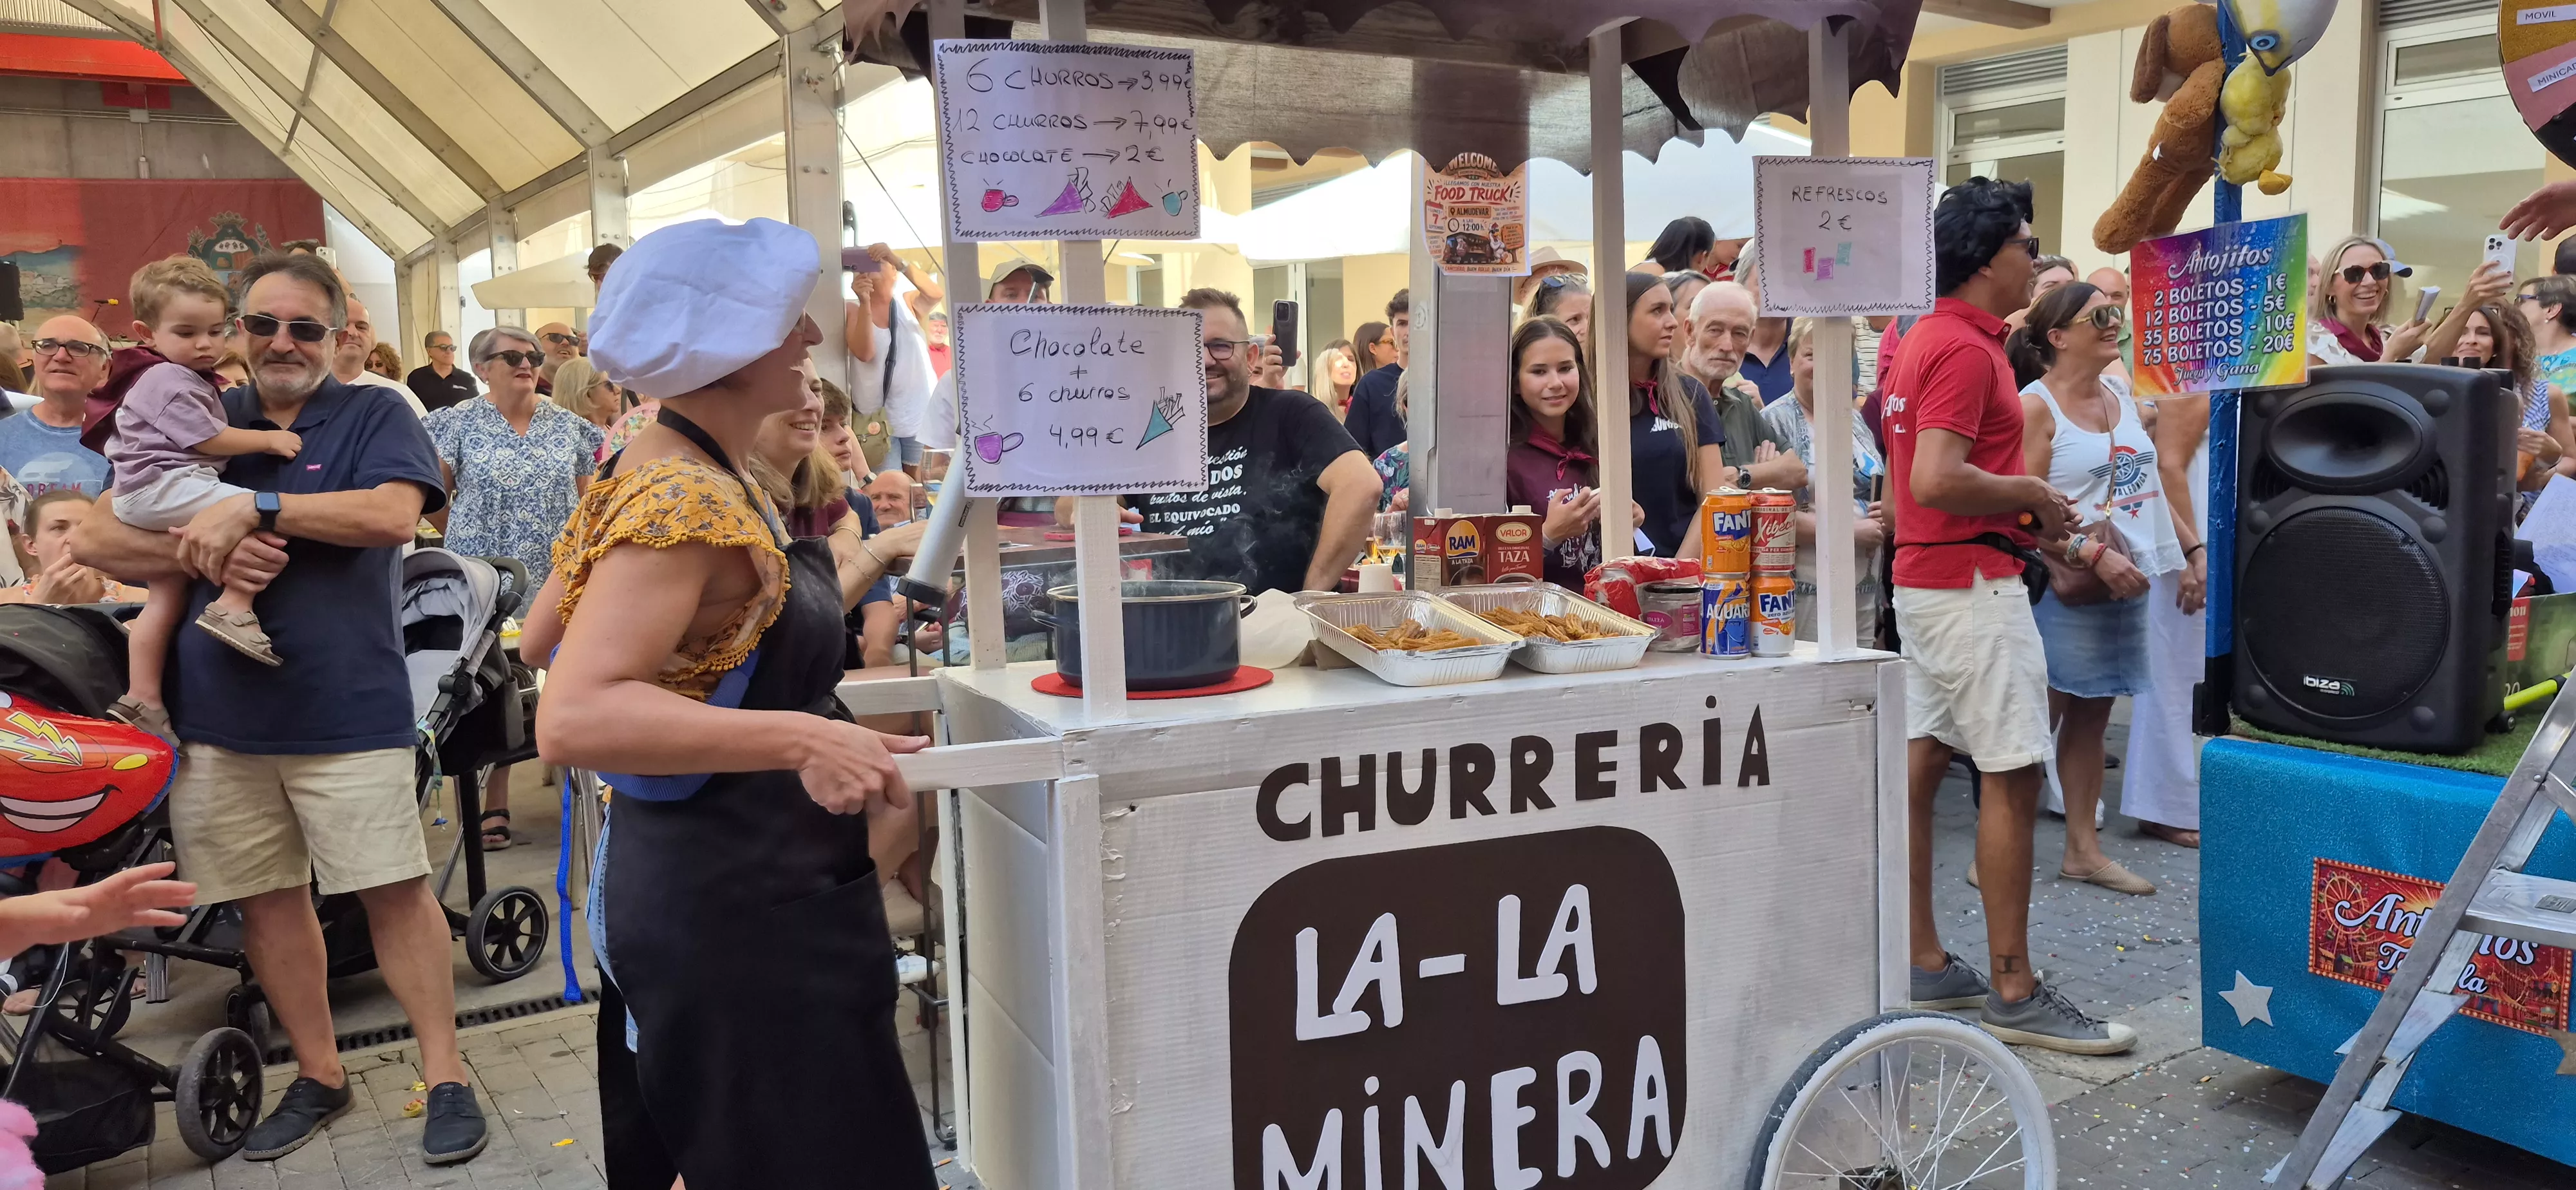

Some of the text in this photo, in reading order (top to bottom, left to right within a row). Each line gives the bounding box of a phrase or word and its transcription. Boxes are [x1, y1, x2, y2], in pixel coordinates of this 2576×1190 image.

[2524, 10, 2557, 21] MOVIL
[967, 58, 1191, 93] 6 CHURROS 3,99€
[952, 109, 1193, 140] 12 CHURROS 7,99€
[961, 148, 1072, 164] CHOCOLATE
[1434, 185, 1514, 202] FOOD TRUCK!
[1792, 185, 1888, 205] REFRESCOS
[1432, 213, 1439, 225] 7
[1457, 207, 1489, 216] ALMUDEVAR
[2168, 245, 2273, 279] Antojitos
[2154, 290, 2164, 308] 2
[2169, 278, 2244, 305] BOLETOS
[2265, 273, 2287, 292] 1€
[2145, 310, 2163, 327] 12
[2168, 298, 2244, 325] BOLETOS
[2263, 294, 2286, 312] 5€
[2143, 330, 2163, 346] 35
[2168, 319, 2243, 344] BOLETOS
[2265, 313, 2295, 333] 10€
[1010, 327, 1145, 359] Chocolate
[2143, 348, 2163, 366] 75
[2167, 339, 2243, 364] BOLETOS
[2262, 333, 2295, 354] 20€
[2174, 362, 2260, 386] Juega y Gana
[1018, 383, 1131, 404] 6 churros
[1049, 426, 1098, 449] 4,99
[1210, 464, 1243, 486] DOS
[1192, 492, 1209, 502] de
[1149, 503, 1241, 524] EL EQUIVOCADO
[1449, 535, 1475, 551] RAM
[1500, 529, 1527, 538] VALOR
[1498, 551, 1530, 563] TAZA
[2303, 674, 2340, 690] ibiza
